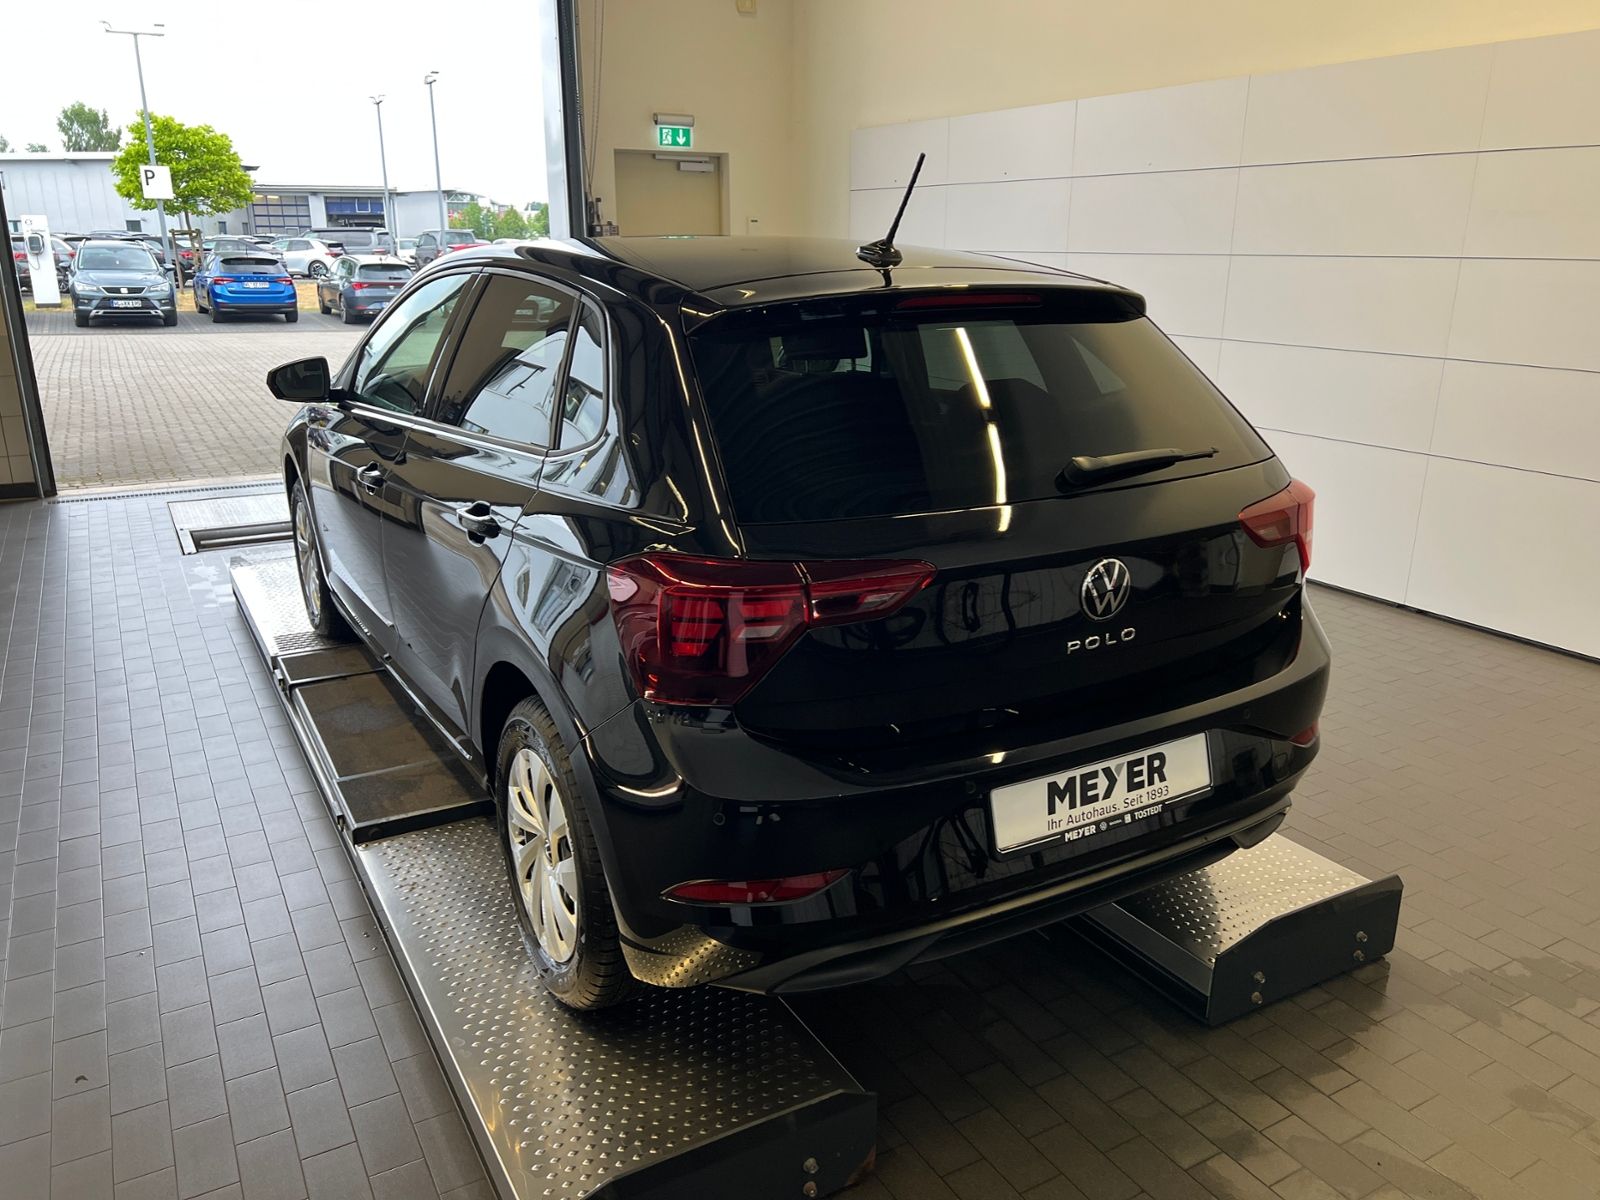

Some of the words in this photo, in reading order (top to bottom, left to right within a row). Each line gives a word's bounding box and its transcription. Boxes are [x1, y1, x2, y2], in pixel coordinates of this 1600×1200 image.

[144, 169, 156, 186] P
[1066, 627, 1136, 655] POLO
[1047, 752, 1167, 816] MEYER
[1047, 818, 1064, 832] Ihr
[1067, 803, 1120, 826] Autohaus.
[1123, 794, 1144, 809] Seit
[1146, 785, 1169, 802] 1893
[1064, 825, 1096, 842] MEYER
[1134, 804, 1163, 820] TOSTEDT
